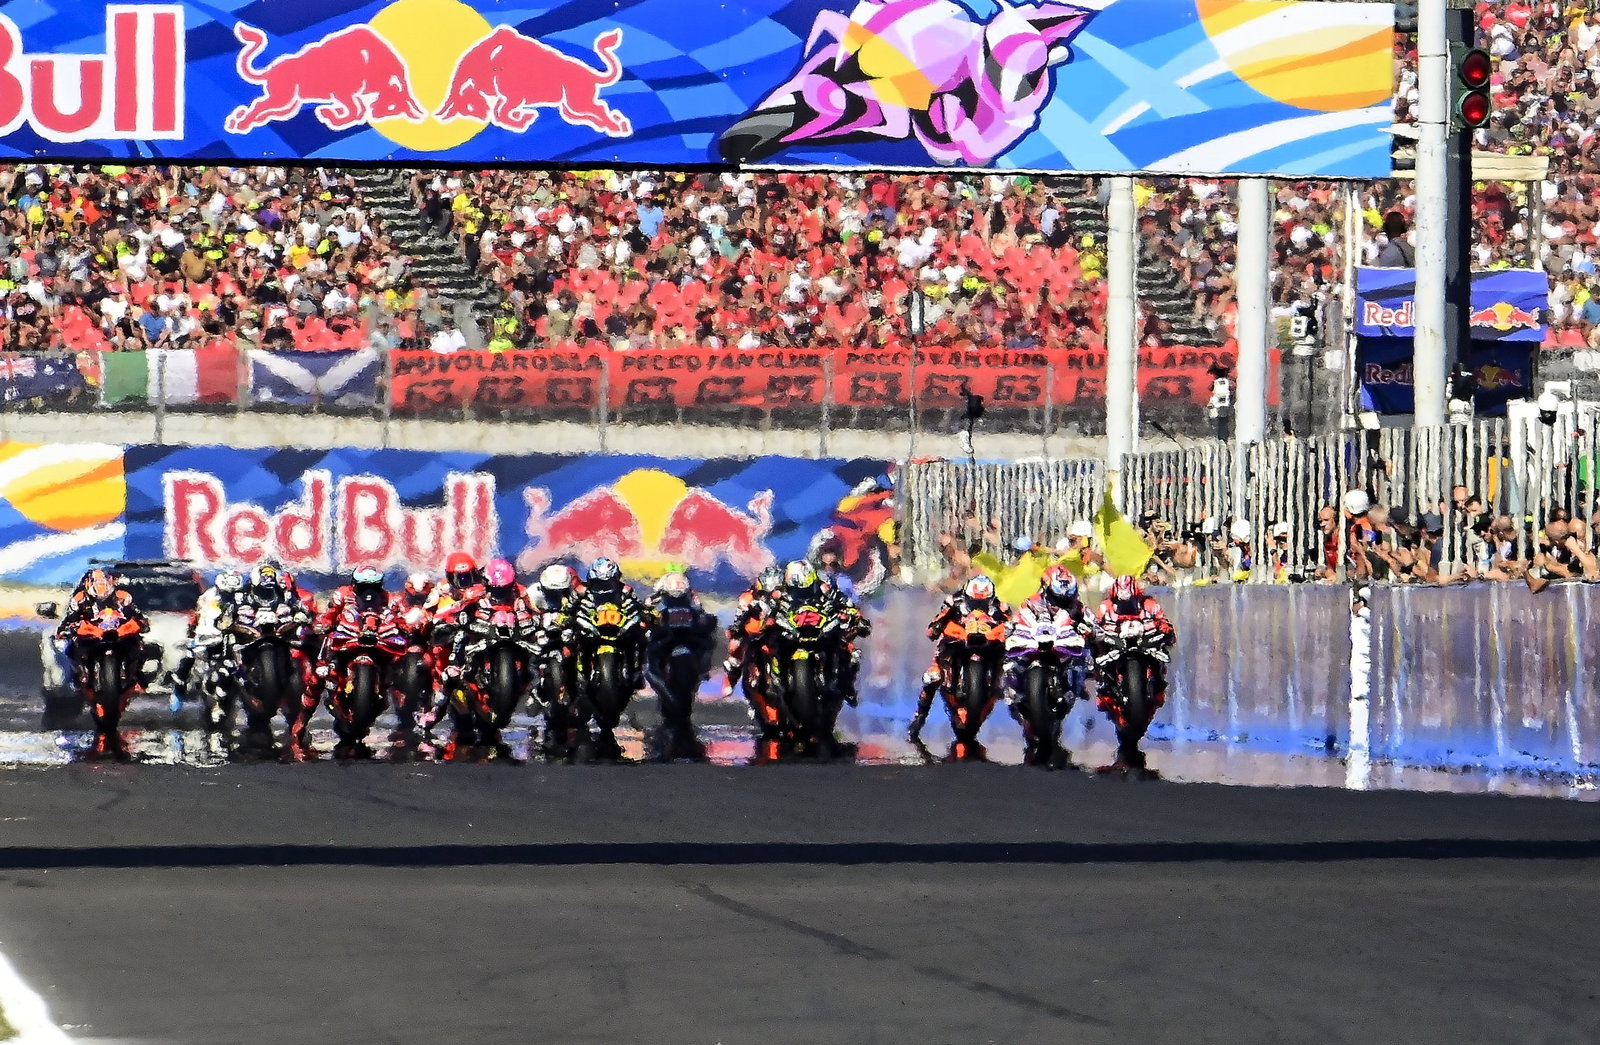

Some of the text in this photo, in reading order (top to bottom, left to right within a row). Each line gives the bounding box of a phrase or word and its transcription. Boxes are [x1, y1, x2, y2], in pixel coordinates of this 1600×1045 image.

[1366, 302, 1411, 326] Red
[1366, 363, 1409, 384] Red
[167, 473, 493, 567] Red Bull
